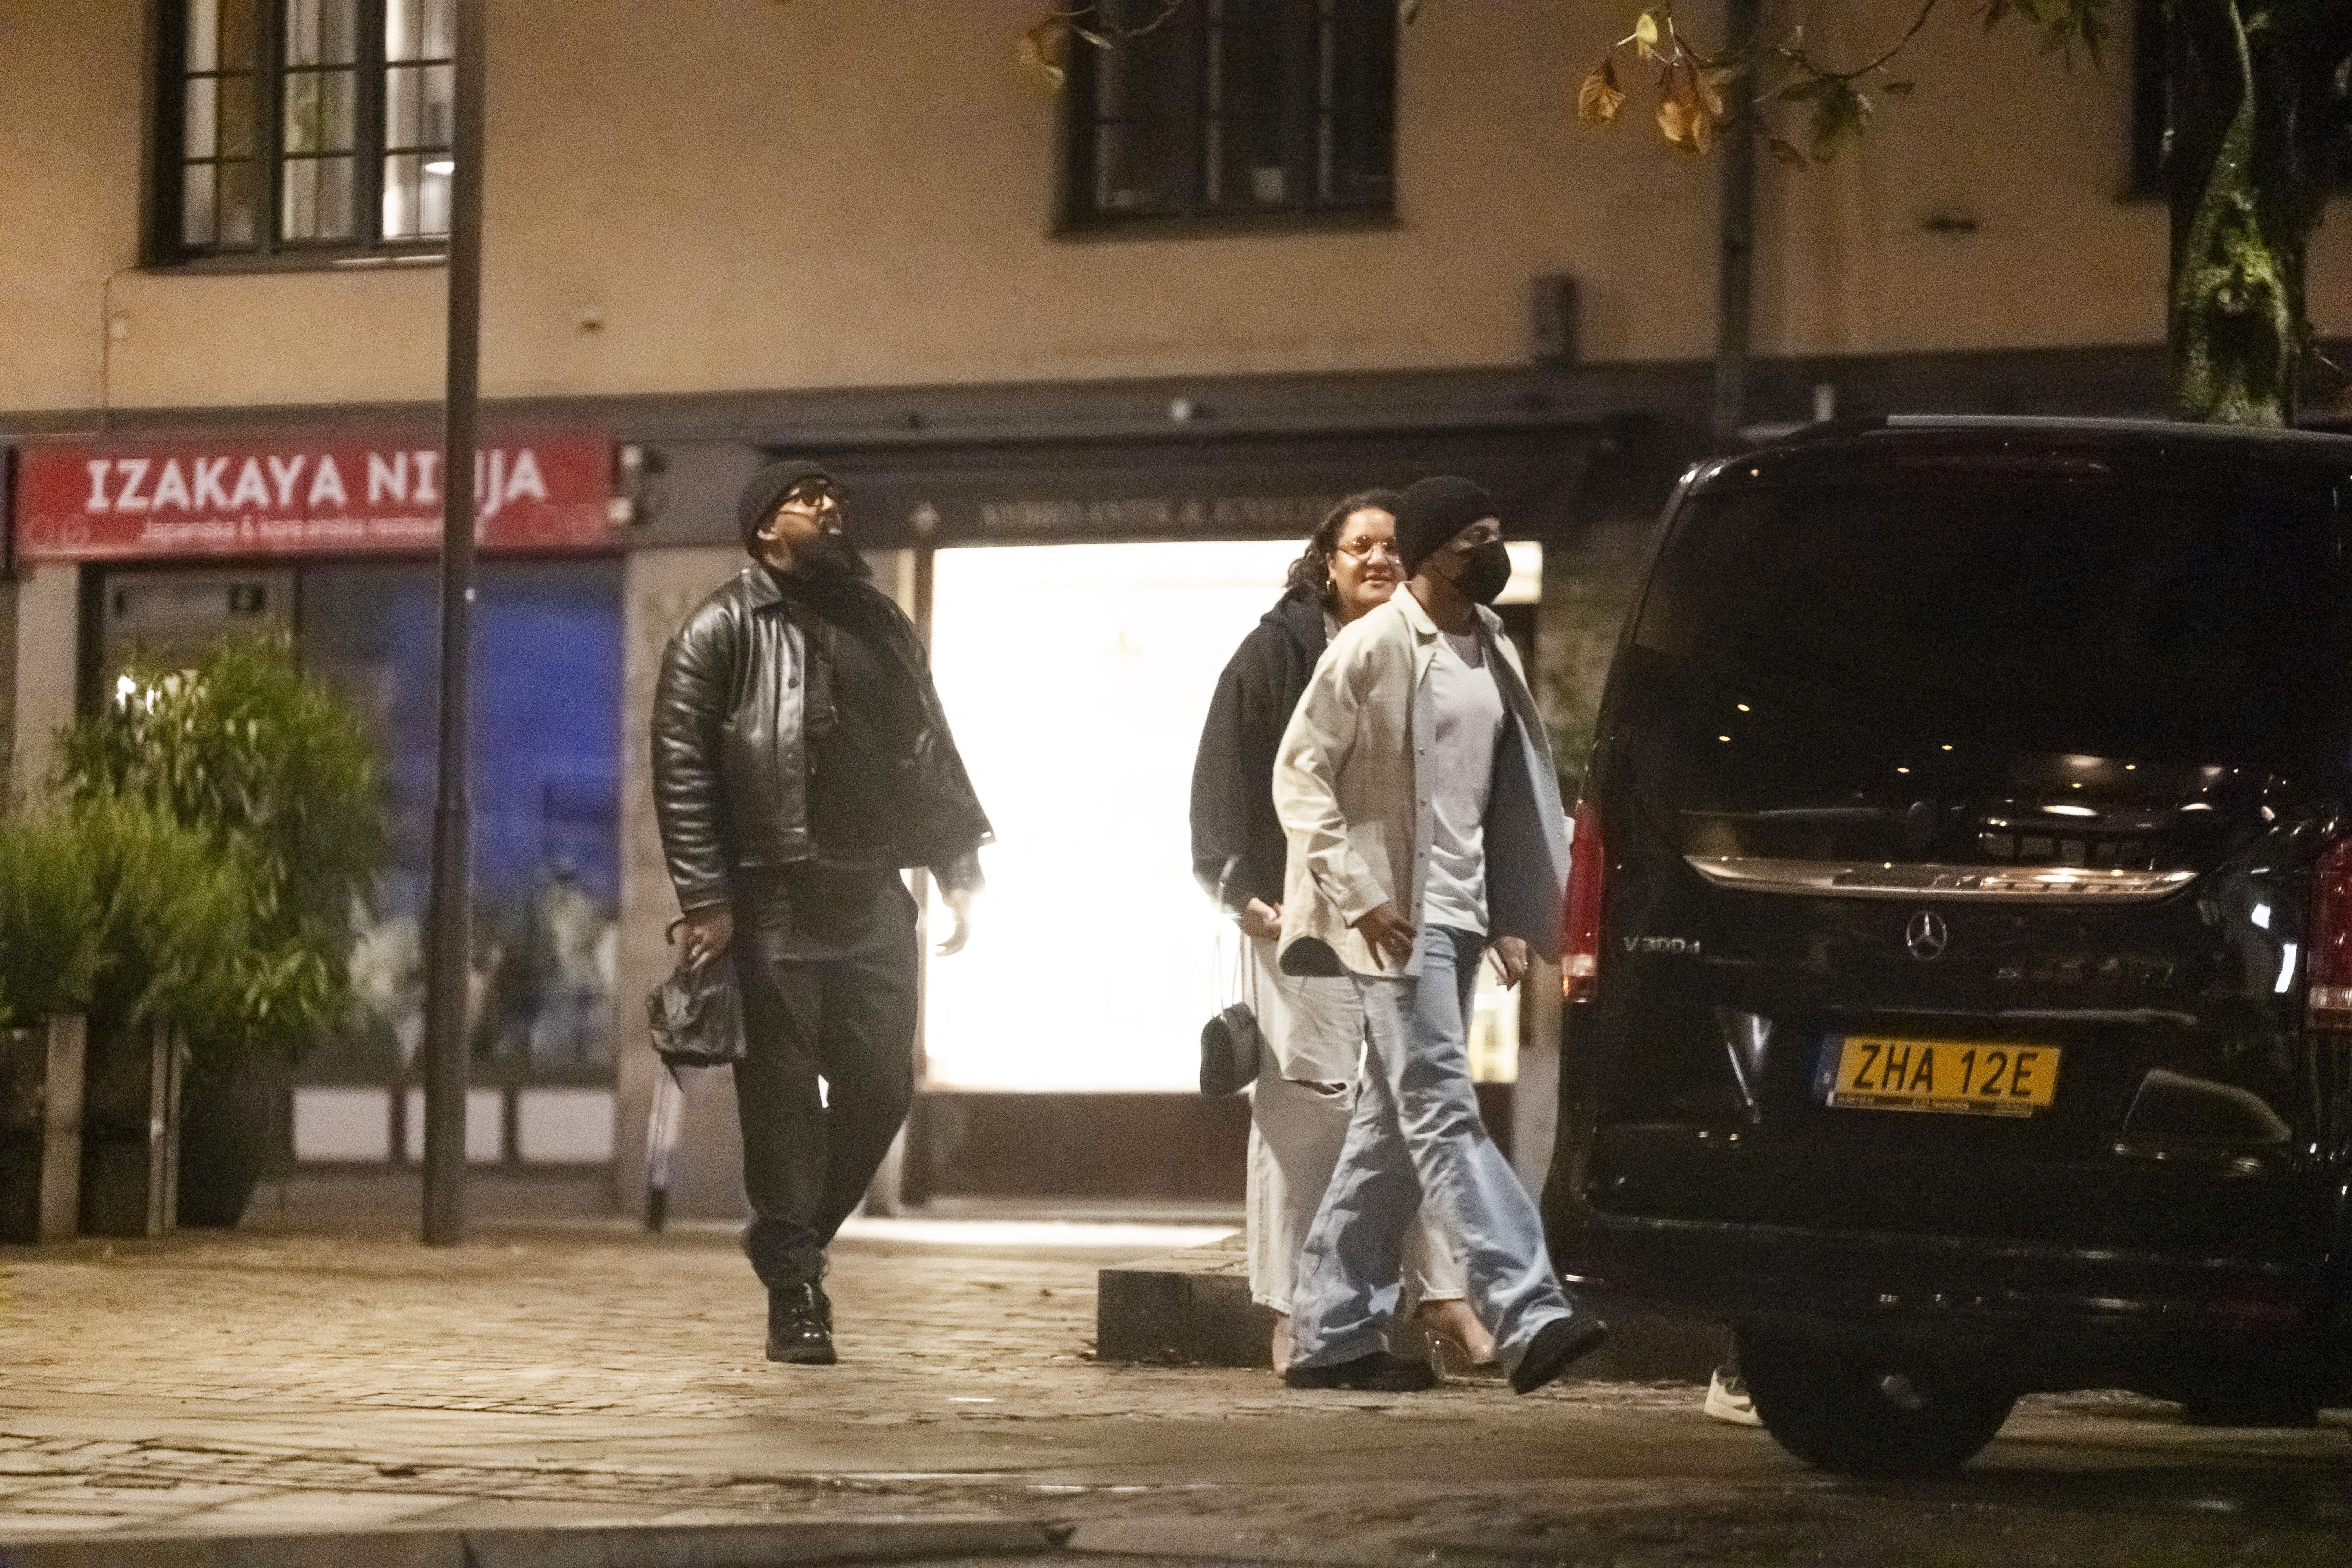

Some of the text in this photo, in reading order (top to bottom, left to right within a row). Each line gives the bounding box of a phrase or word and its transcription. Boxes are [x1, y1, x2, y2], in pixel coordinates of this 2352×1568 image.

[86, 453, 348, 513] IZAKAYA
[1852, 1043, 2039, 1097] ZHA 12E
